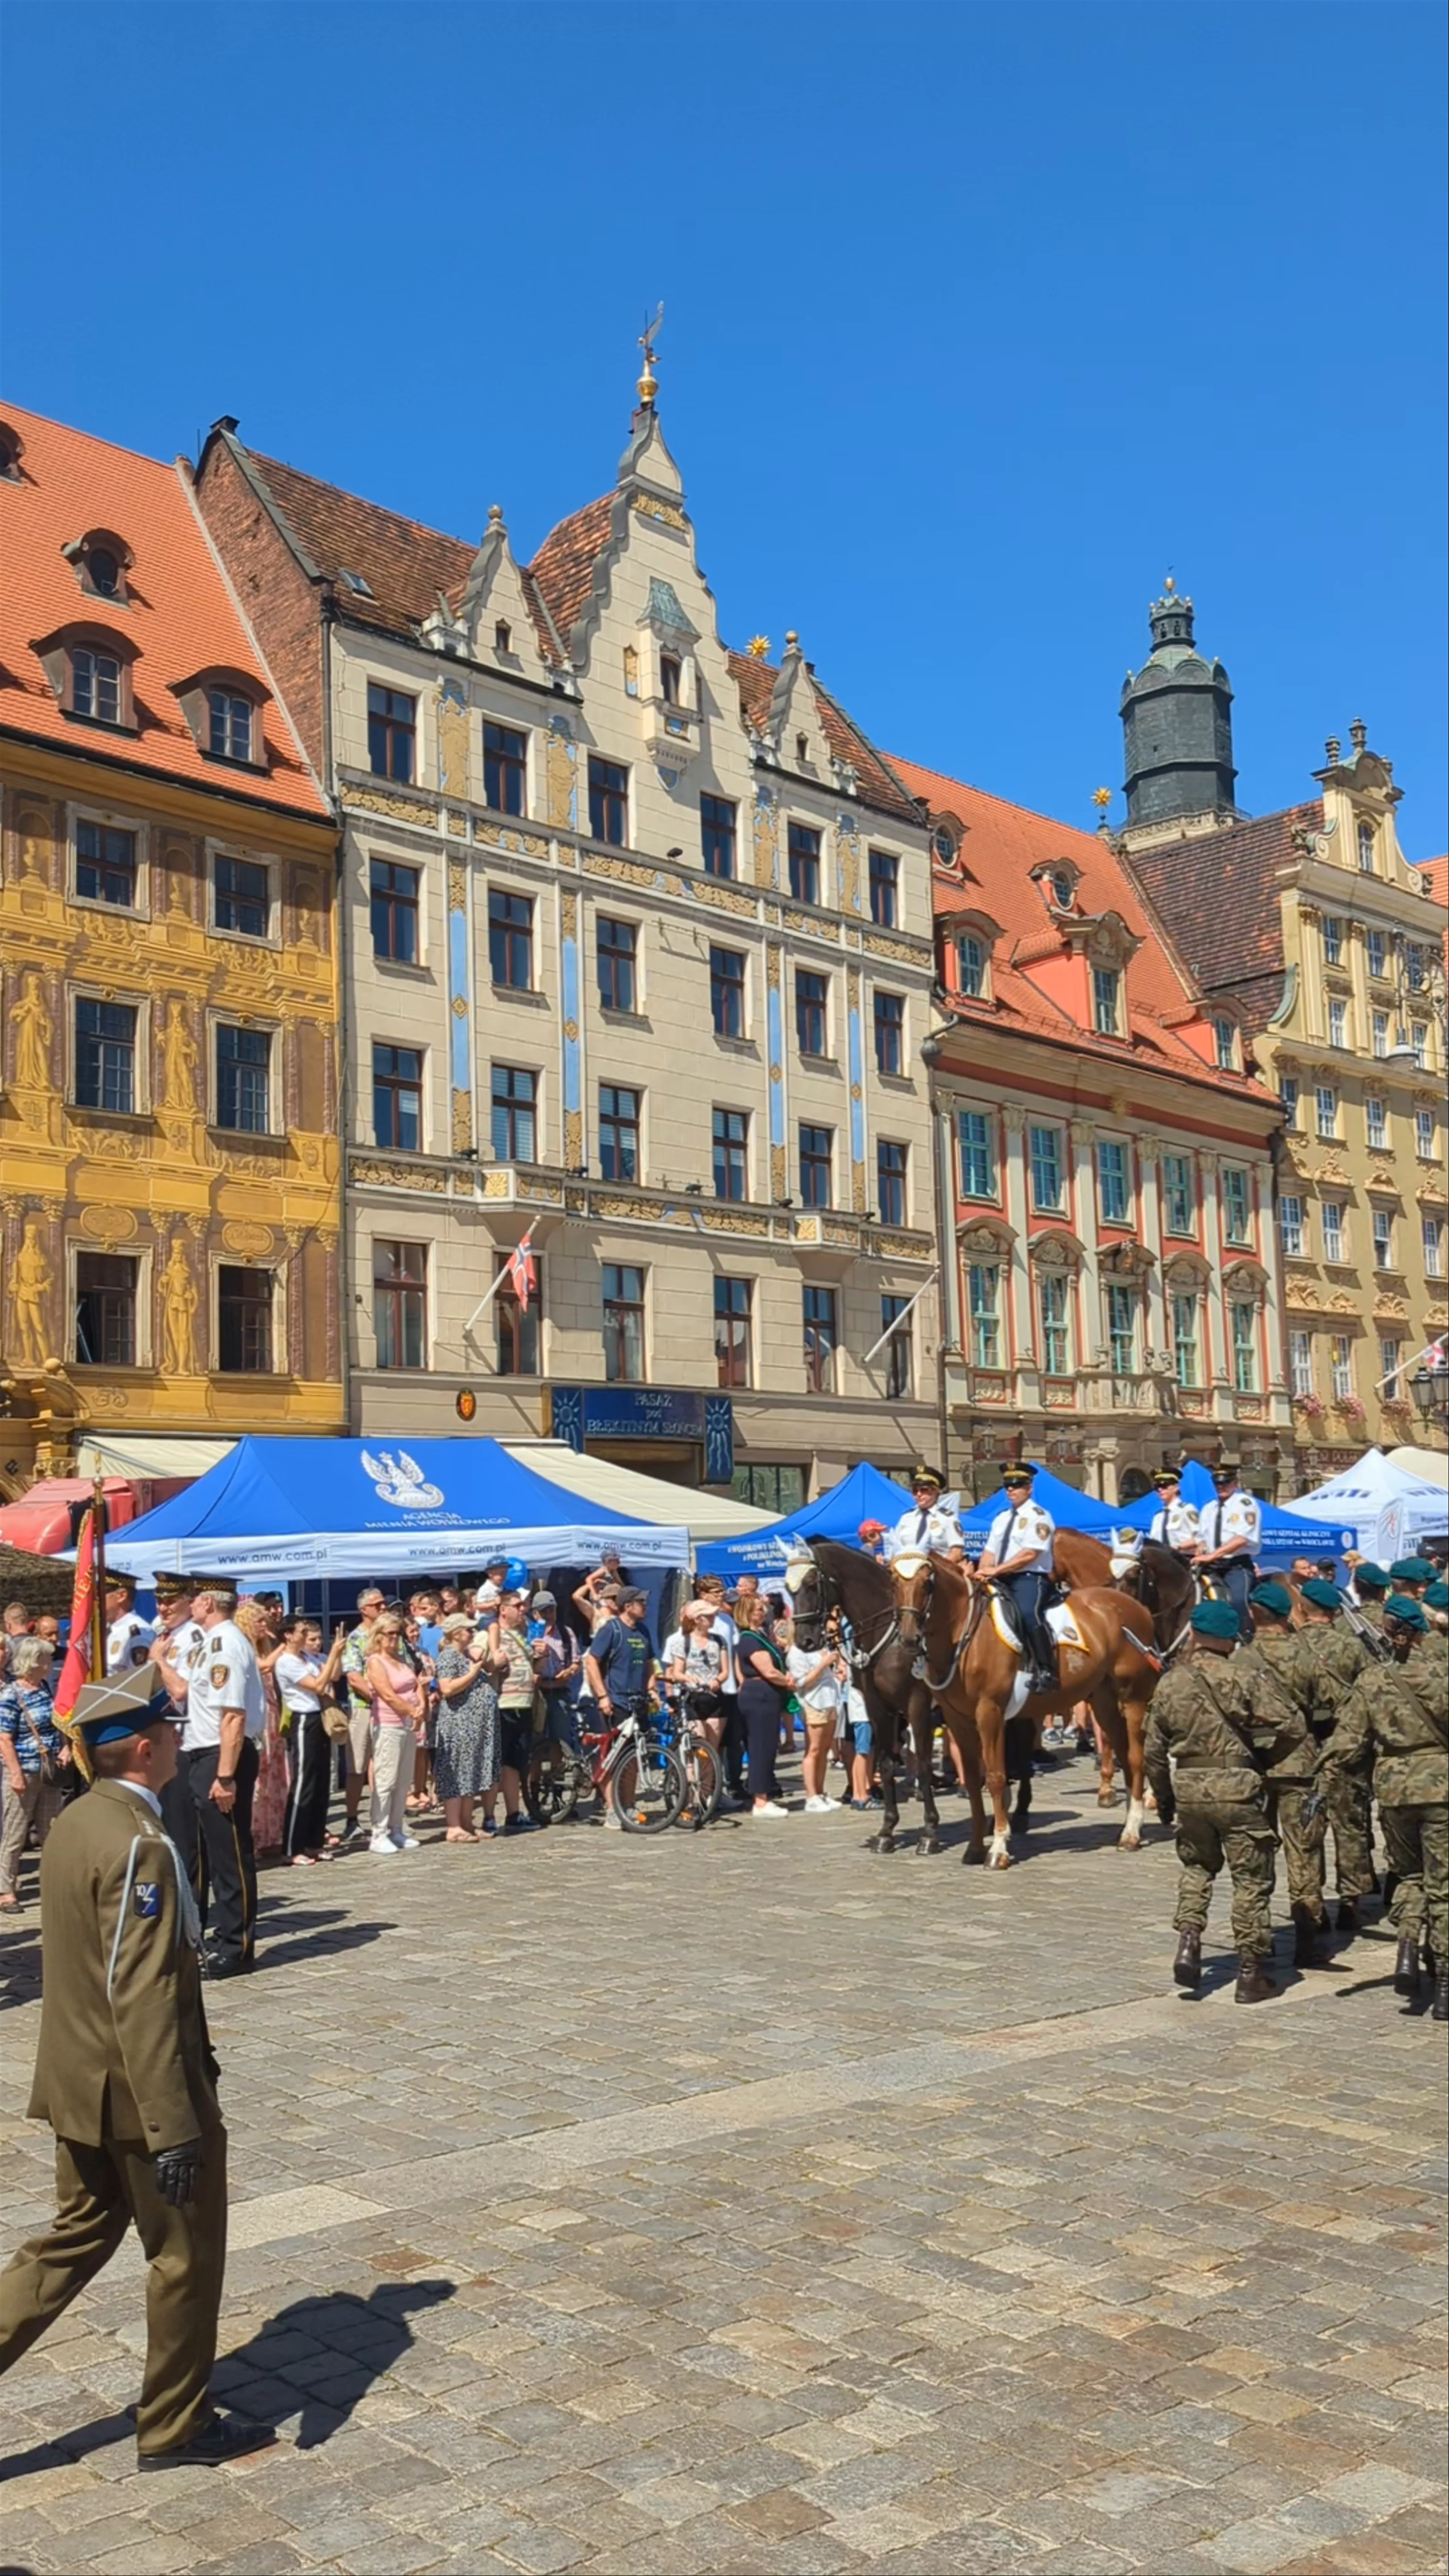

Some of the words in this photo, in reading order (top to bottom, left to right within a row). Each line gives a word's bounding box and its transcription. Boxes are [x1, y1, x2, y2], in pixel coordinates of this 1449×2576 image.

[402, 1511, 462, 1521] AGENCJA
[217, 1548, 328, 1564] www.amw.com.pl
[408, 1543, 506, 1556] www.amw.com.pl
[136, 1884, 146, 1897] 10
